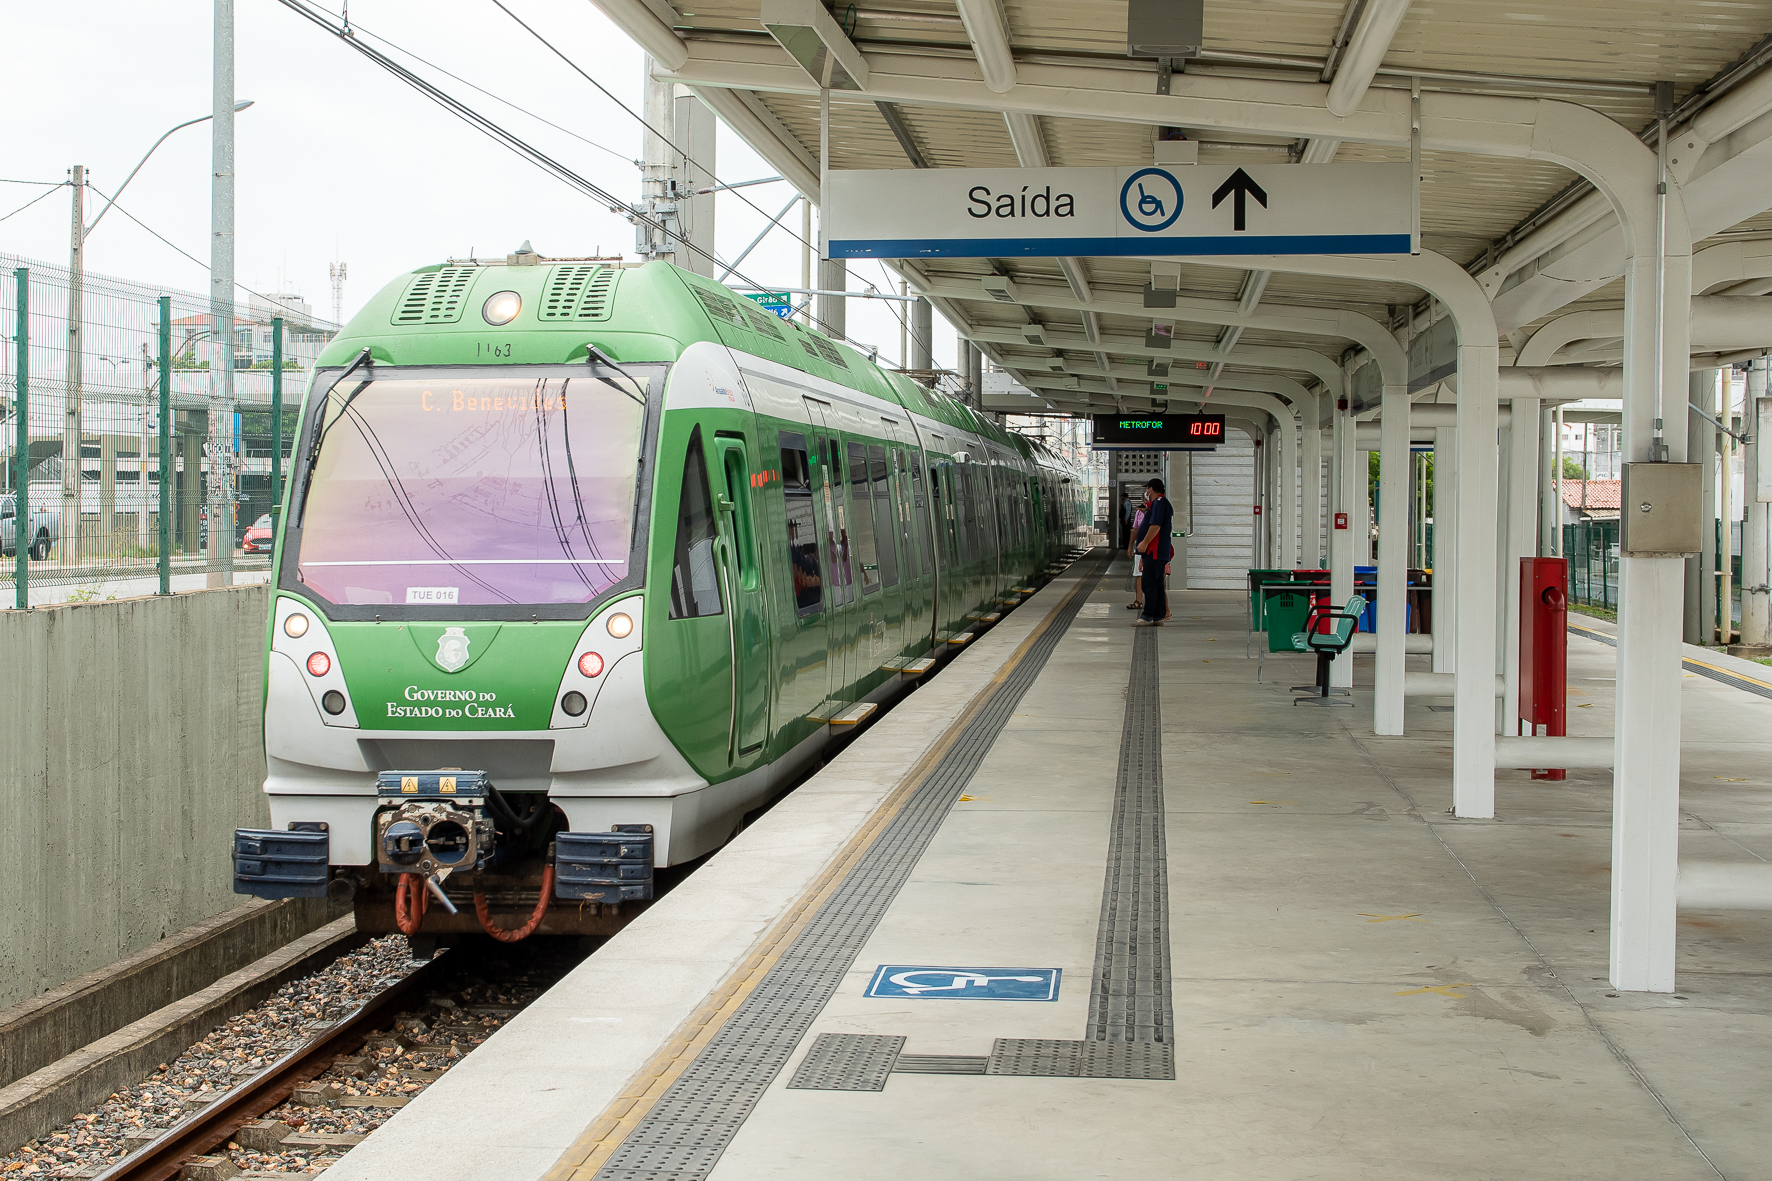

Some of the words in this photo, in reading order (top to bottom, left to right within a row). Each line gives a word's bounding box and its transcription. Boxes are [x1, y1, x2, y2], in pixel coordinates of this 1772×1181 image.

[967, 185, 1075, 219] Saída
[476, 342, 512, 358] 1163
[421, 390, 441, 412] C.
[1119, 420, 1163, 429] METROFOR
[412, 590, 433, 600] TUE
[435, 590, 454, 600] 016
[404, 685, 477, 702] GOVERNO
[386, 702, 443, 718] ESTADO
